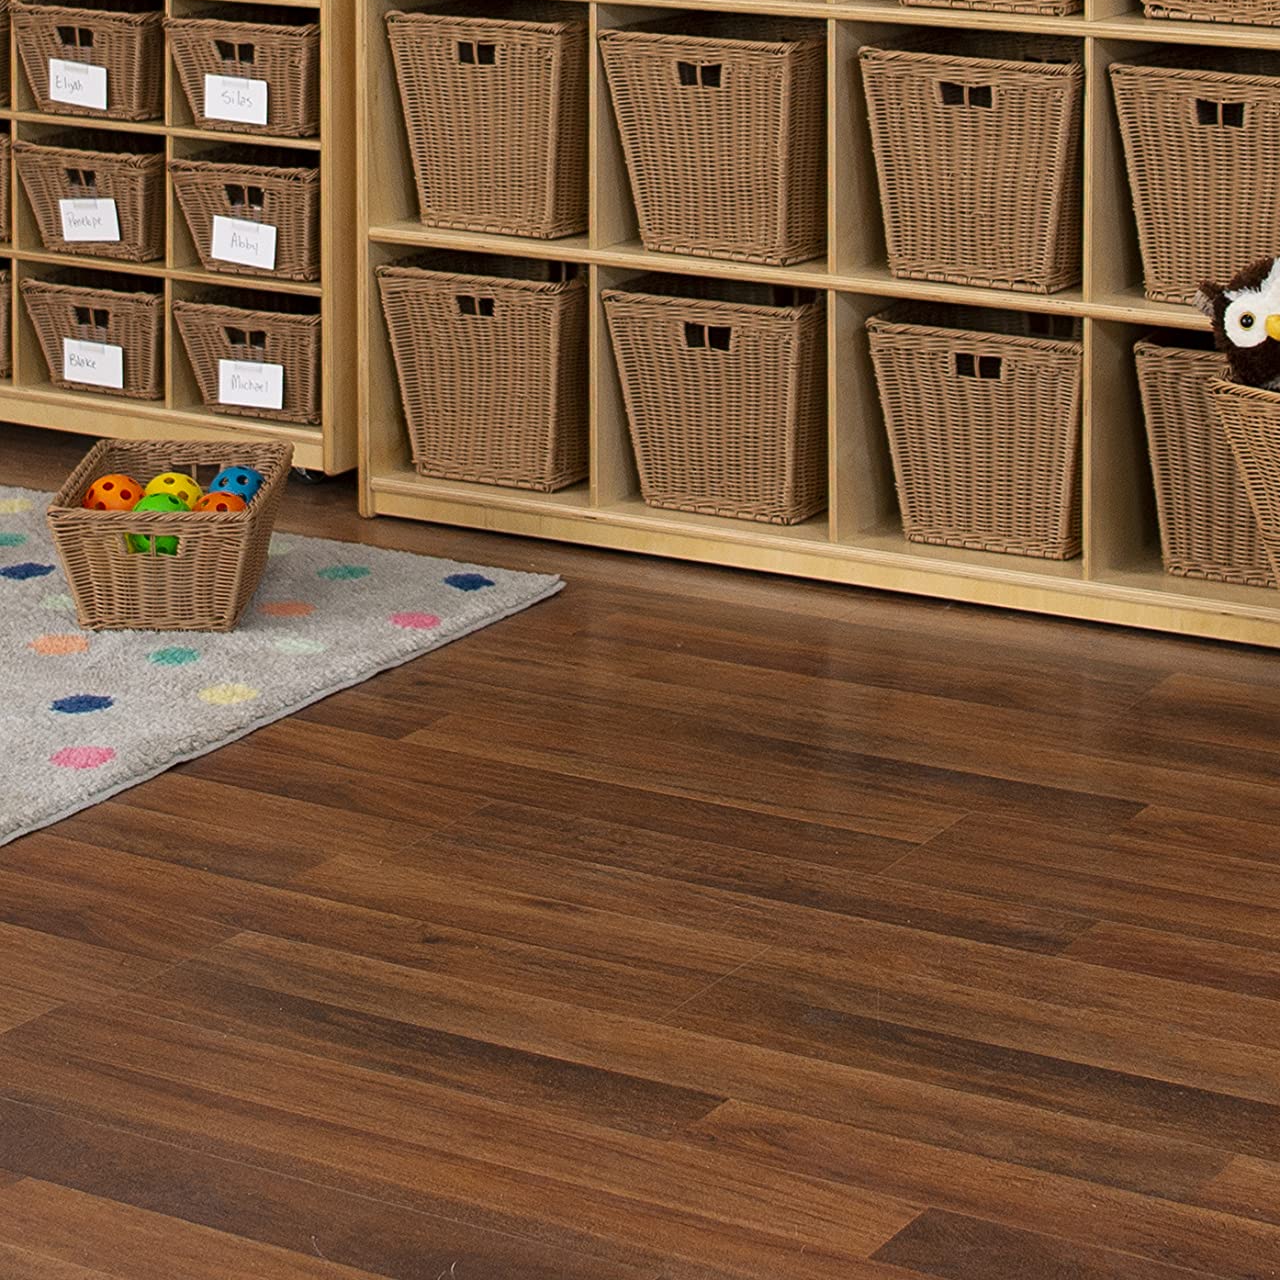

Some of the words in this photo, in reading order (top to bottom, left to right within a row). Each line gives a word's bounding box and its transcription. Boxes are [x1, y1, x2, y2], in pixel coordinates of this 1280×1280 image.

[221, 90, 254, 109] Silas
[67, 214, 102, 229] Penelope
[231, 232, 259, 256] Abby
[69, 353, 97, 370] Blake
[231, 374, 269, 393] Michael
